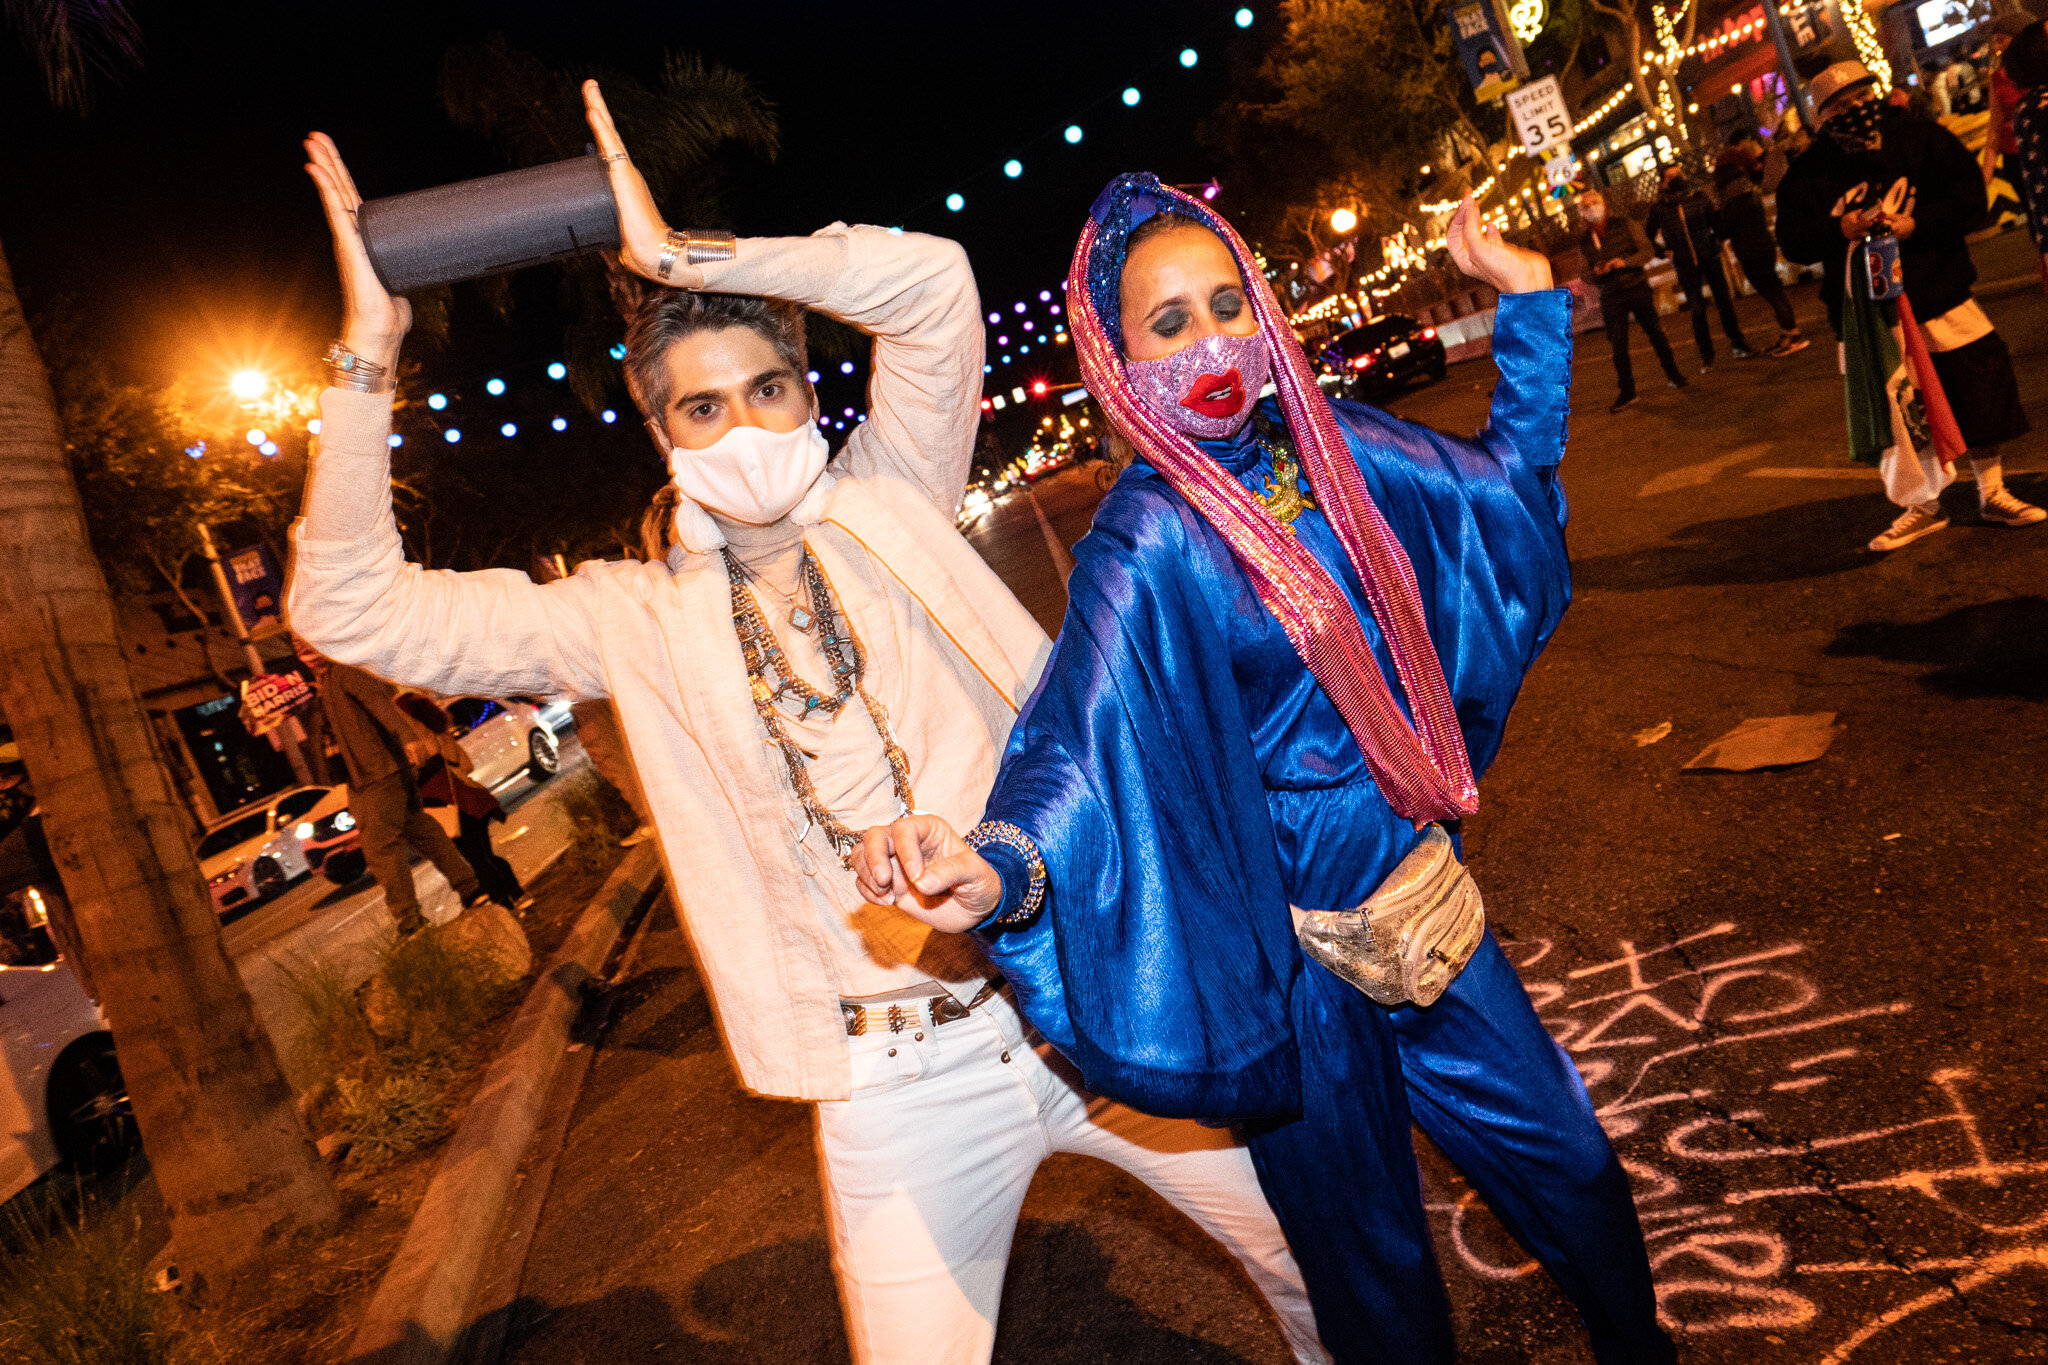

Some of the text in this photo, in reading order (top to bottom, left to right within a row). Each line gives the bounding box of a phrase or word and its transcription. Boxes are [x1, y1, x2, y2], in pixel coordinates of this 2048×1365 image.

[1514, 84, 1555, 108] SPEED
[1521, 101, 1555, 121] LIMIT
[1526, 115, 1566, 146] 35
[245, 670, 304, 708] BIDN
[250, 682, 309, 718] HARRIS
